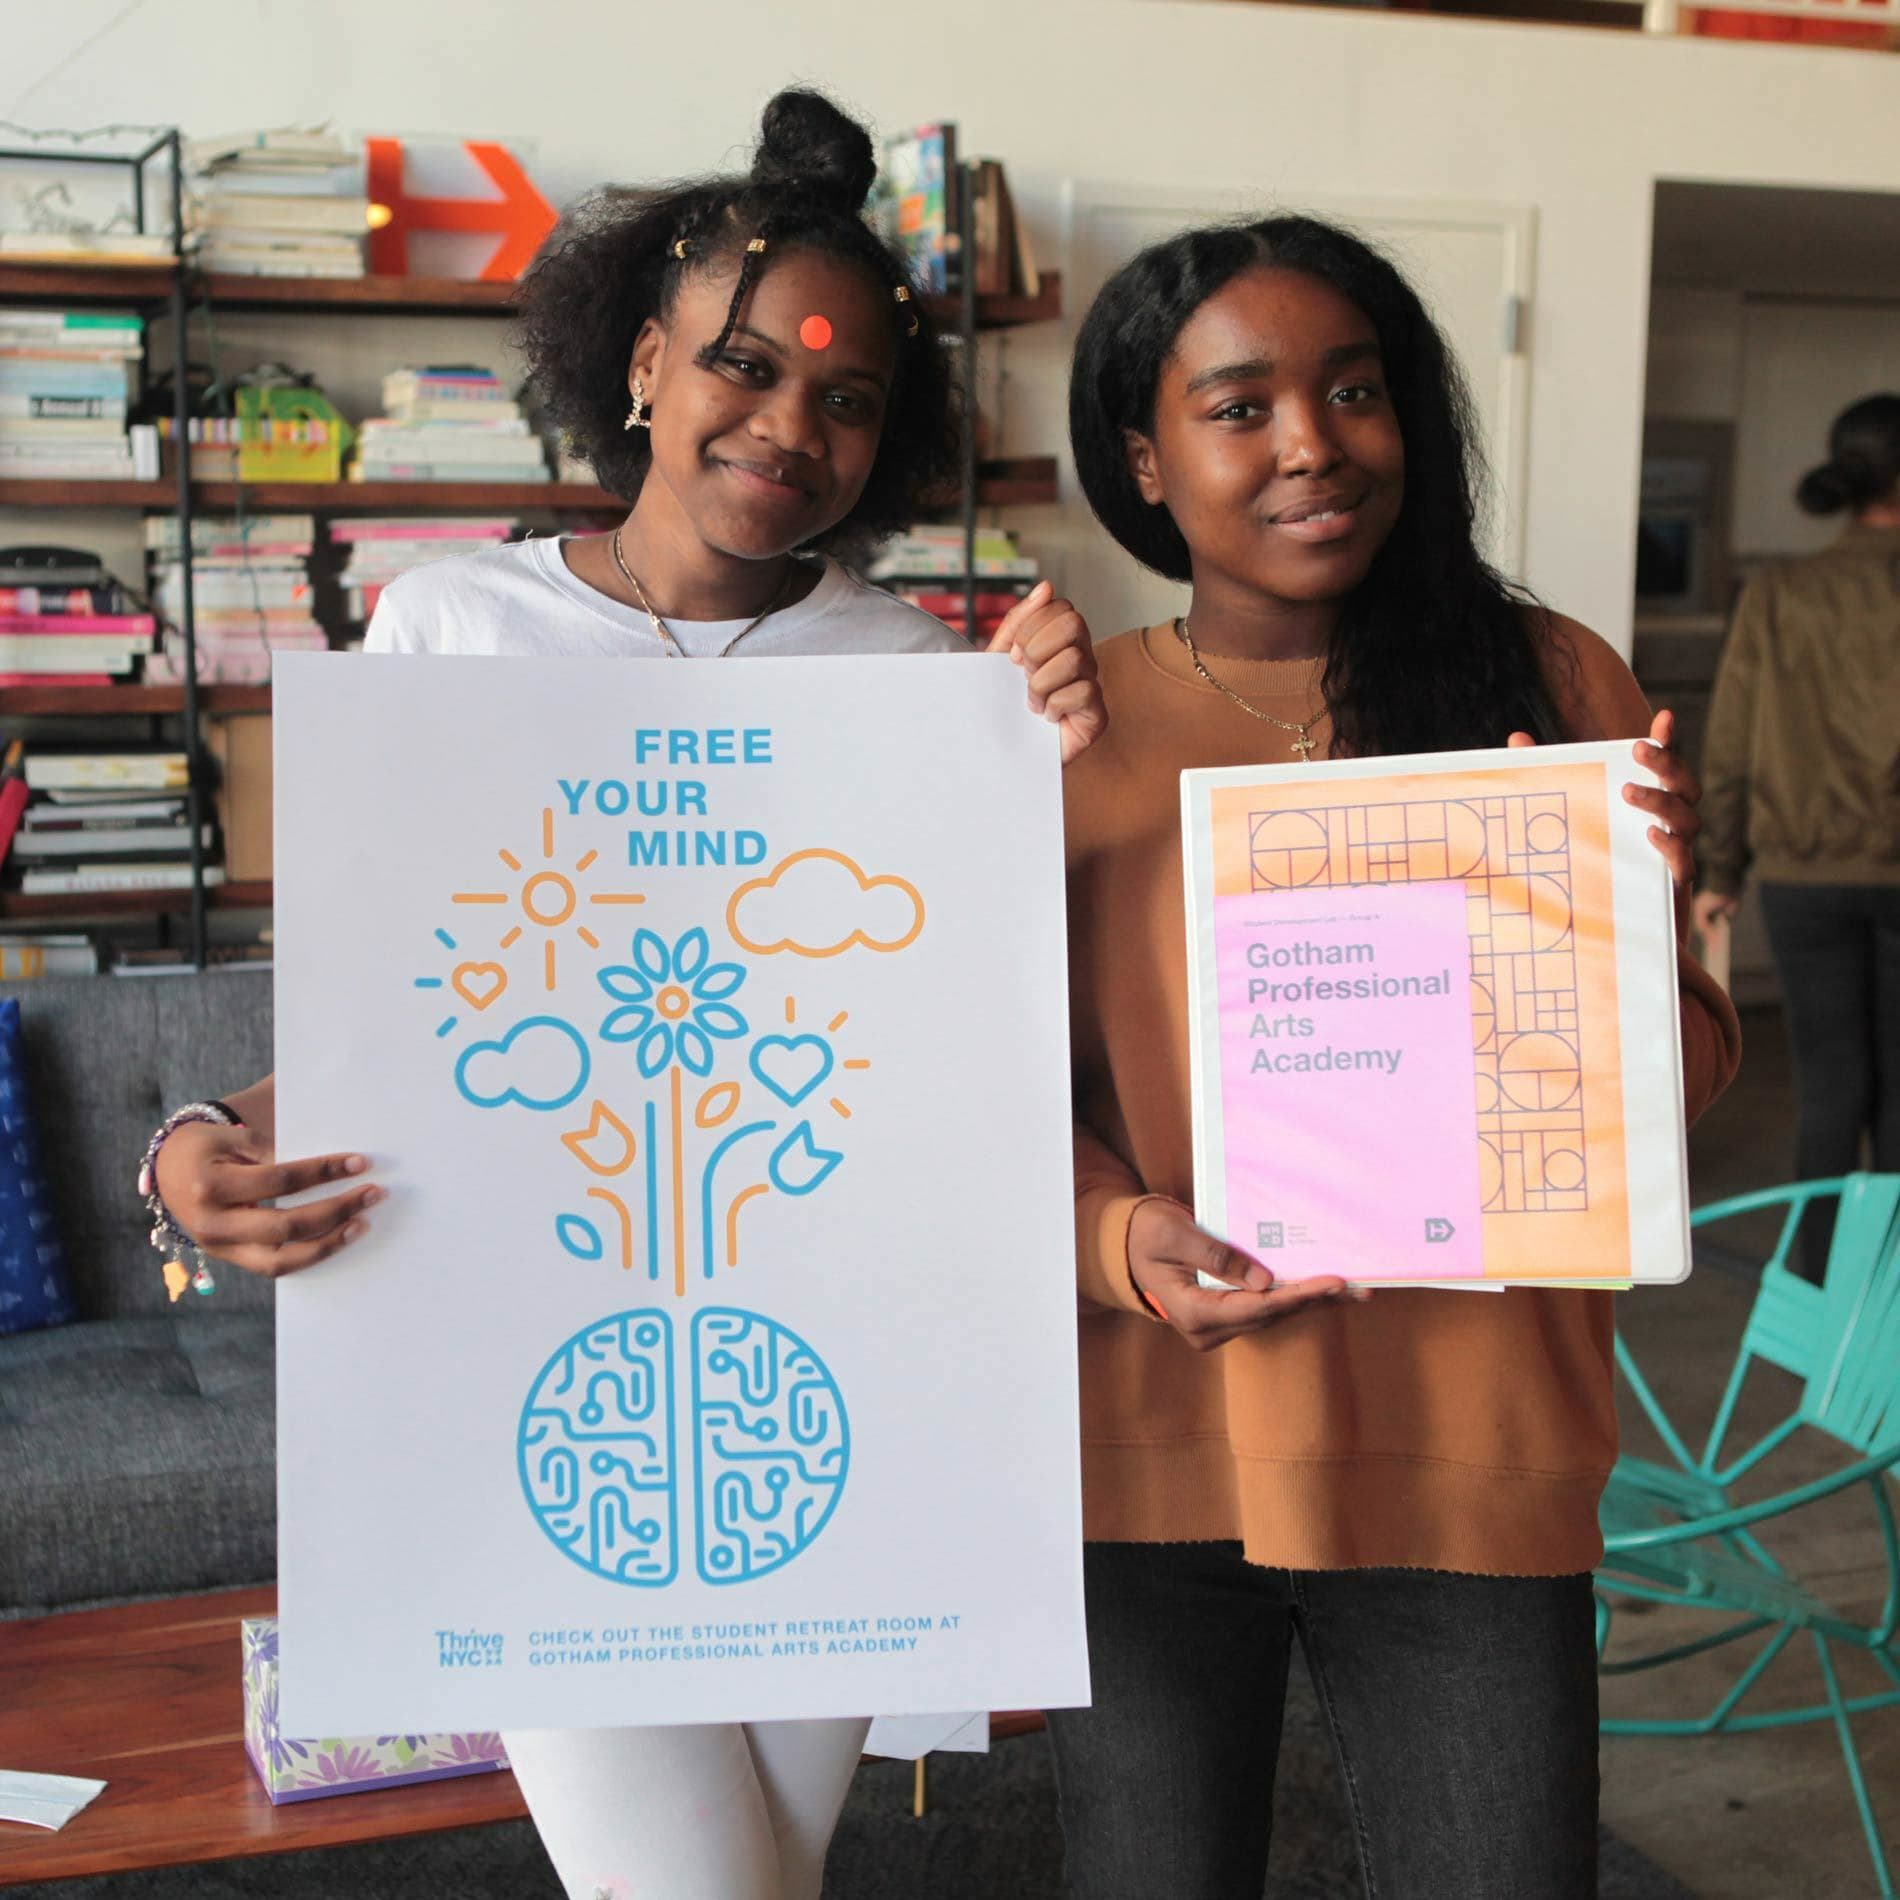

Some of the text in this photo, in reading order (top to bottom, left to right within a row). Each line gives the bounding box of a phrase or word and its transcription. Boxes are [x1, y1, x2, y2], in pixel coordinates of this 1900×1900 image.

[635, 727, 773, 765] FREE
[557, 779, 708, 816] YOUR
[627, 829, 768, 867] MIND
[1246, 941, 1375, 969] Gotham
[1248, 968, 1451, 1004] Professional
[1250, 1013, 1315, 1039] Arts
[1250, 1046, 1402, 1074] Academy
[435, 1629, 505, 1650] Thrive
[528, 1615, 961, 1646] CHECK OUT THE STUDENT RETREAT ROOM AT
[438, 1651, 483, 1667] NYC
[528, 1637, 918, 1666] GOTHAM PROFESSIONAL ARTS ACADEMY
